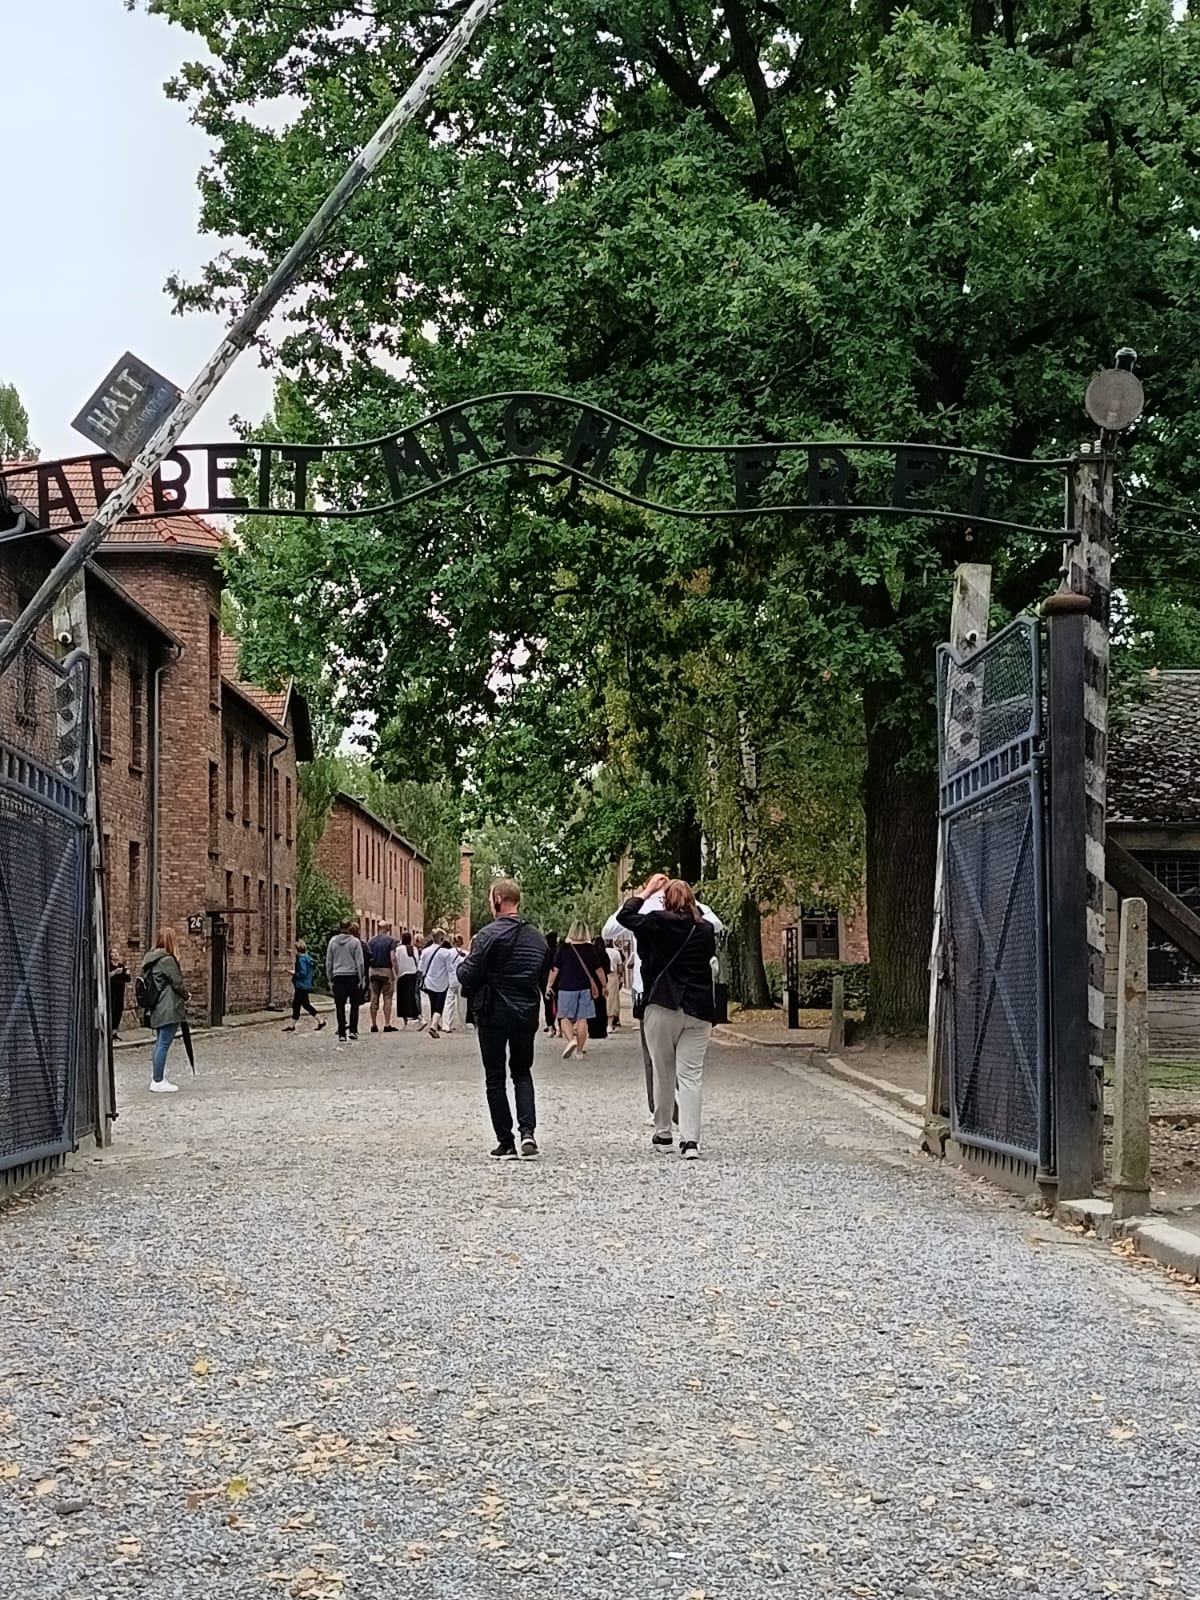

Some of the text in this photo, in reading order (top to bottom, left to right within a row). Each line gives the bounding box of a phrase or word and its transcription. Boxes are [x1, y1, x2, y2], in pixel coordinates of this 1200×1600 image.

[86, 367, 146, 437] HALT
[381, 397, 668, 502] MACHT
[736, 447, 986, 516] FREI
